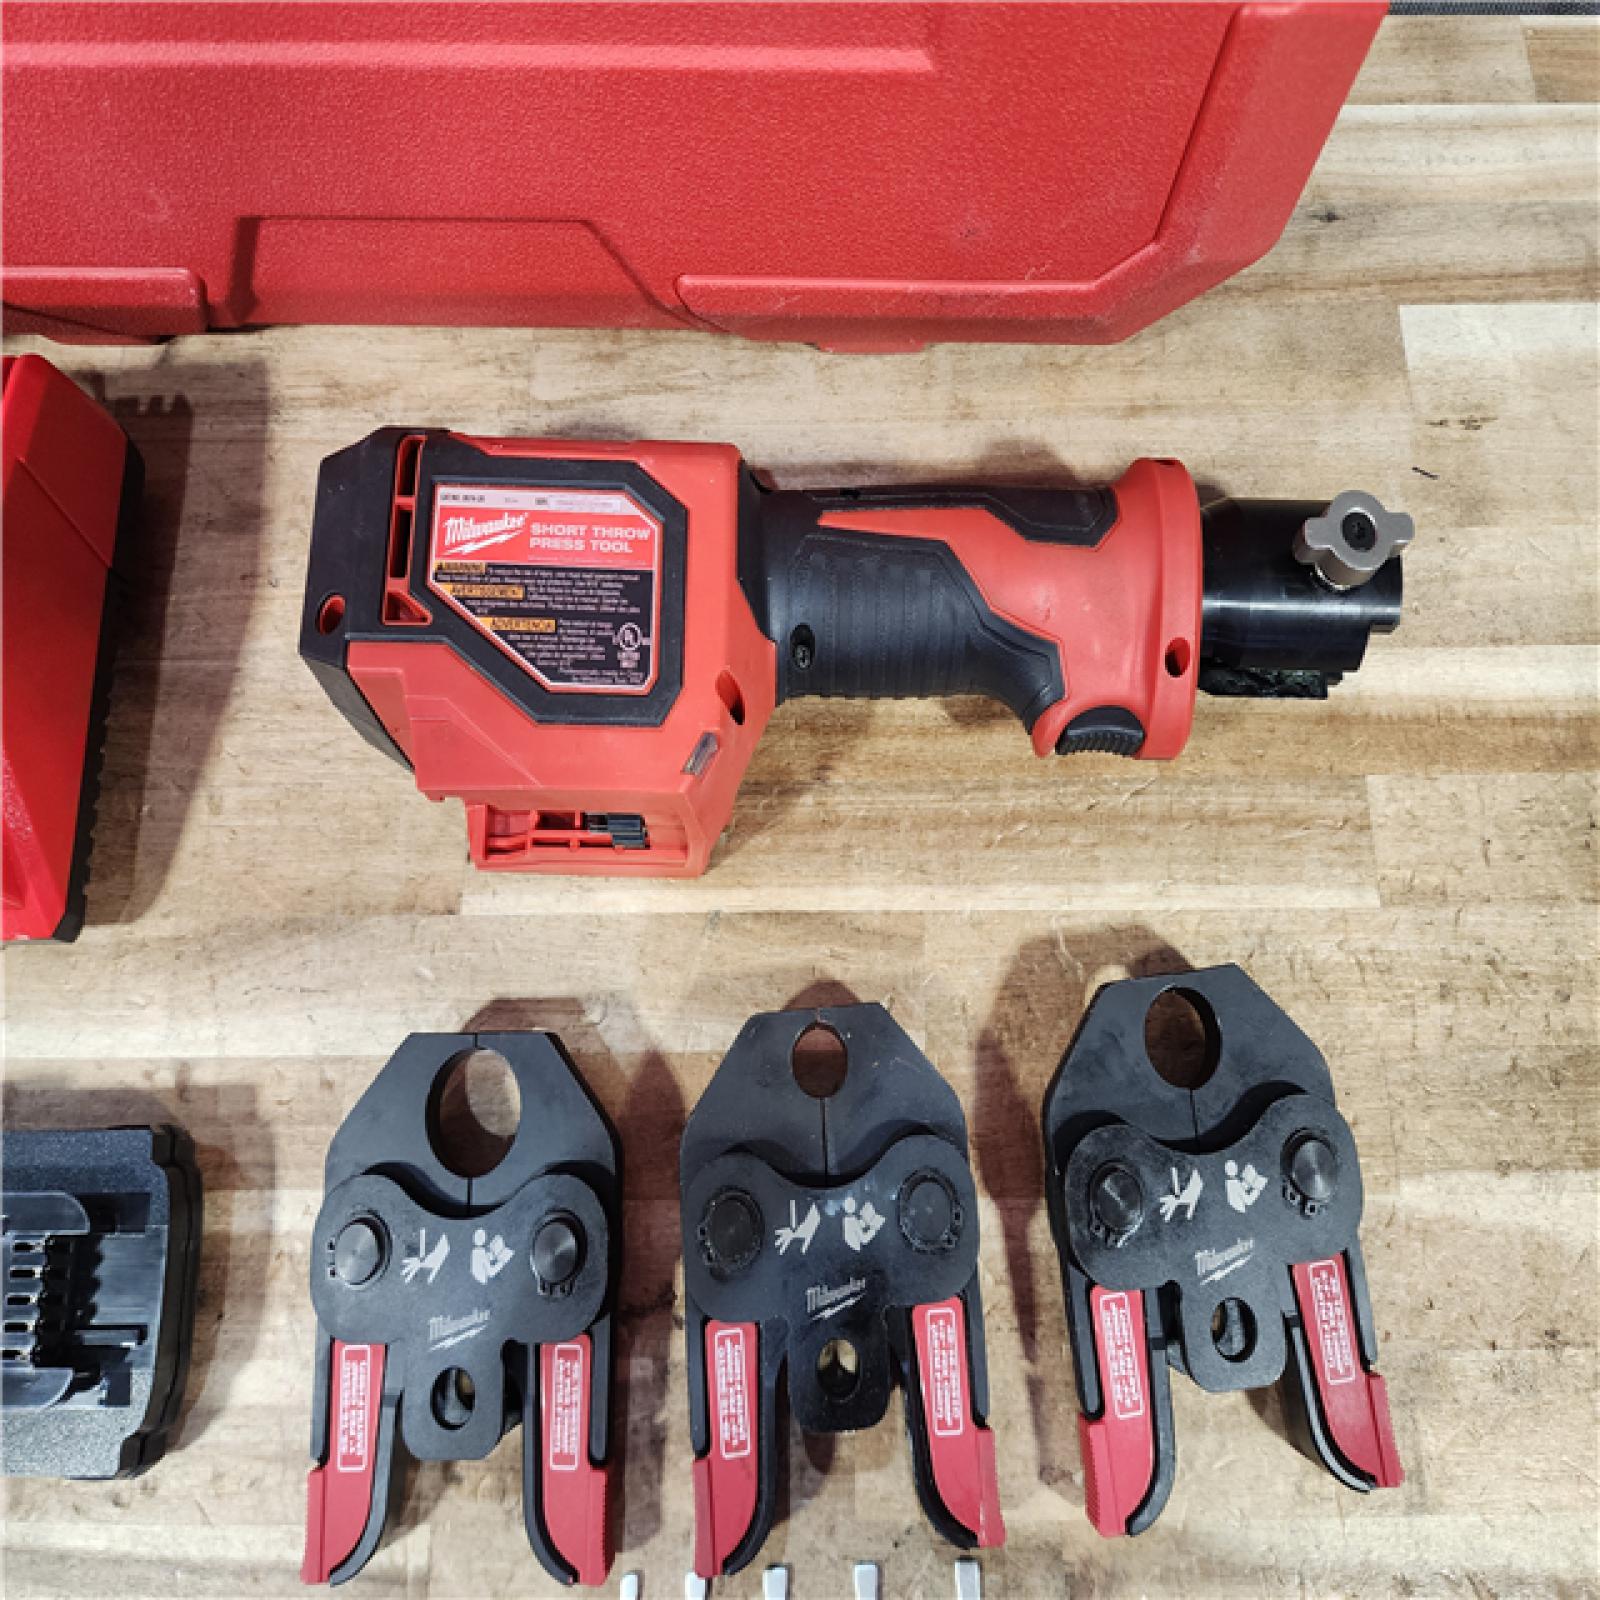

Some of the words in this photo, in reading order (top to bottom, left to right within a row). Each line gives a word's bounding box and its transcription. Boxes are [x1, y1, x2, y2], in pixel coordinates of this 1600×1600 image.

[443, 512, 526, 546] Milwaukee
[531, 523, 587, 536] SHORT
[592, 526, 650, 540] THROW
[530, 537, 586, 551] PRESS
[590, 540, 633, 553] TOOL
